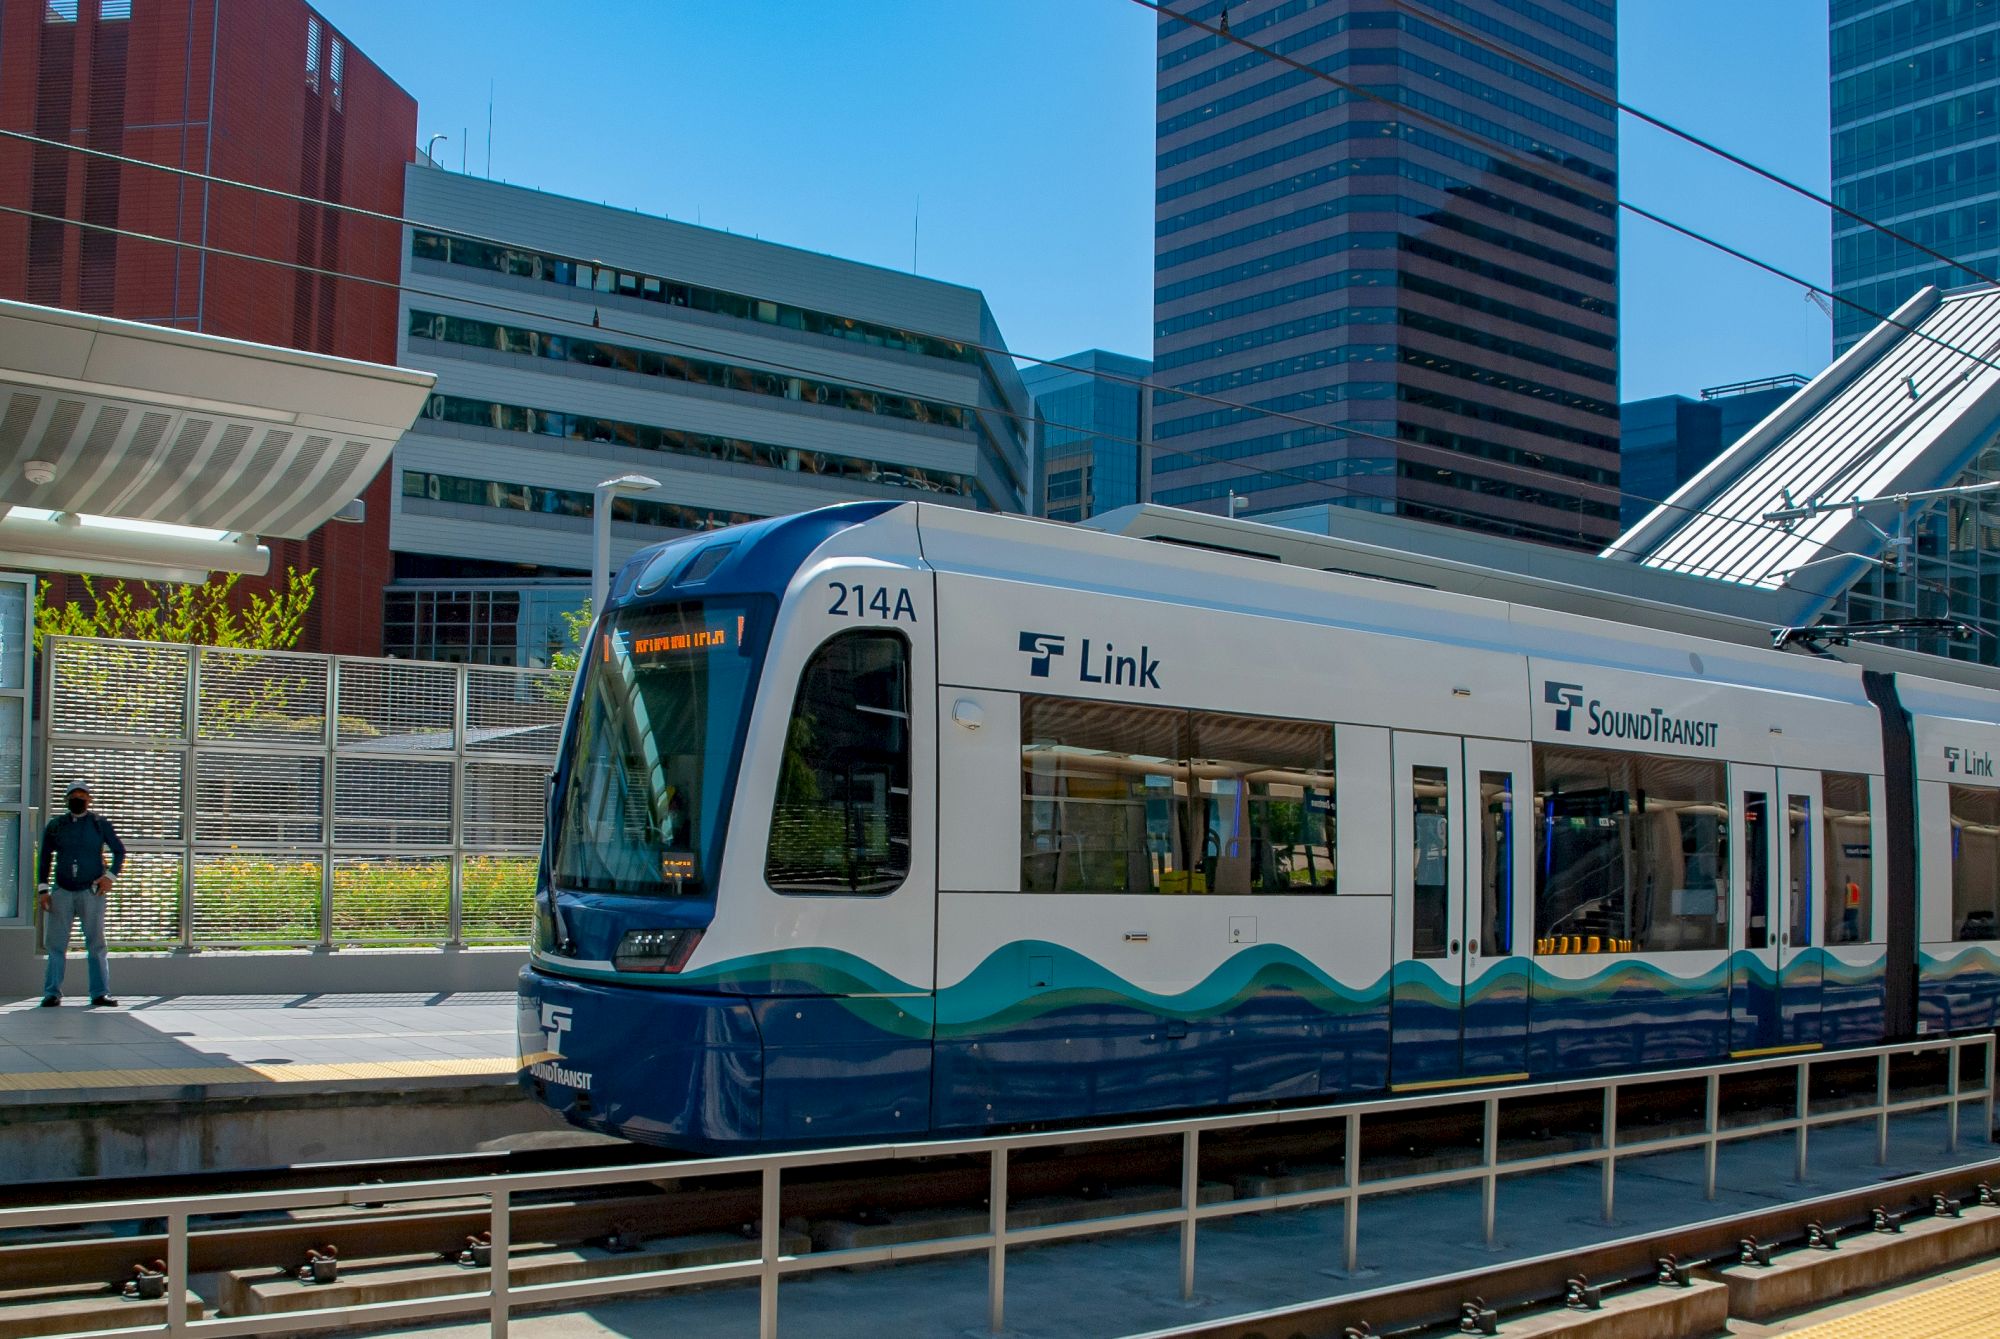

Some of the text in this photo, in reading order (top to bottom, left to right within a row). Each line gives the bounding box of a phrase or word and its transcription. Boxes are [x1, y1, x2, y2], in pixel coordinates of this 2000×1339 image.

[828, 582, 917, 622] 214A
[1079, 638, 1161, 689] Link
[1964, 749, 1993, 777] Link
